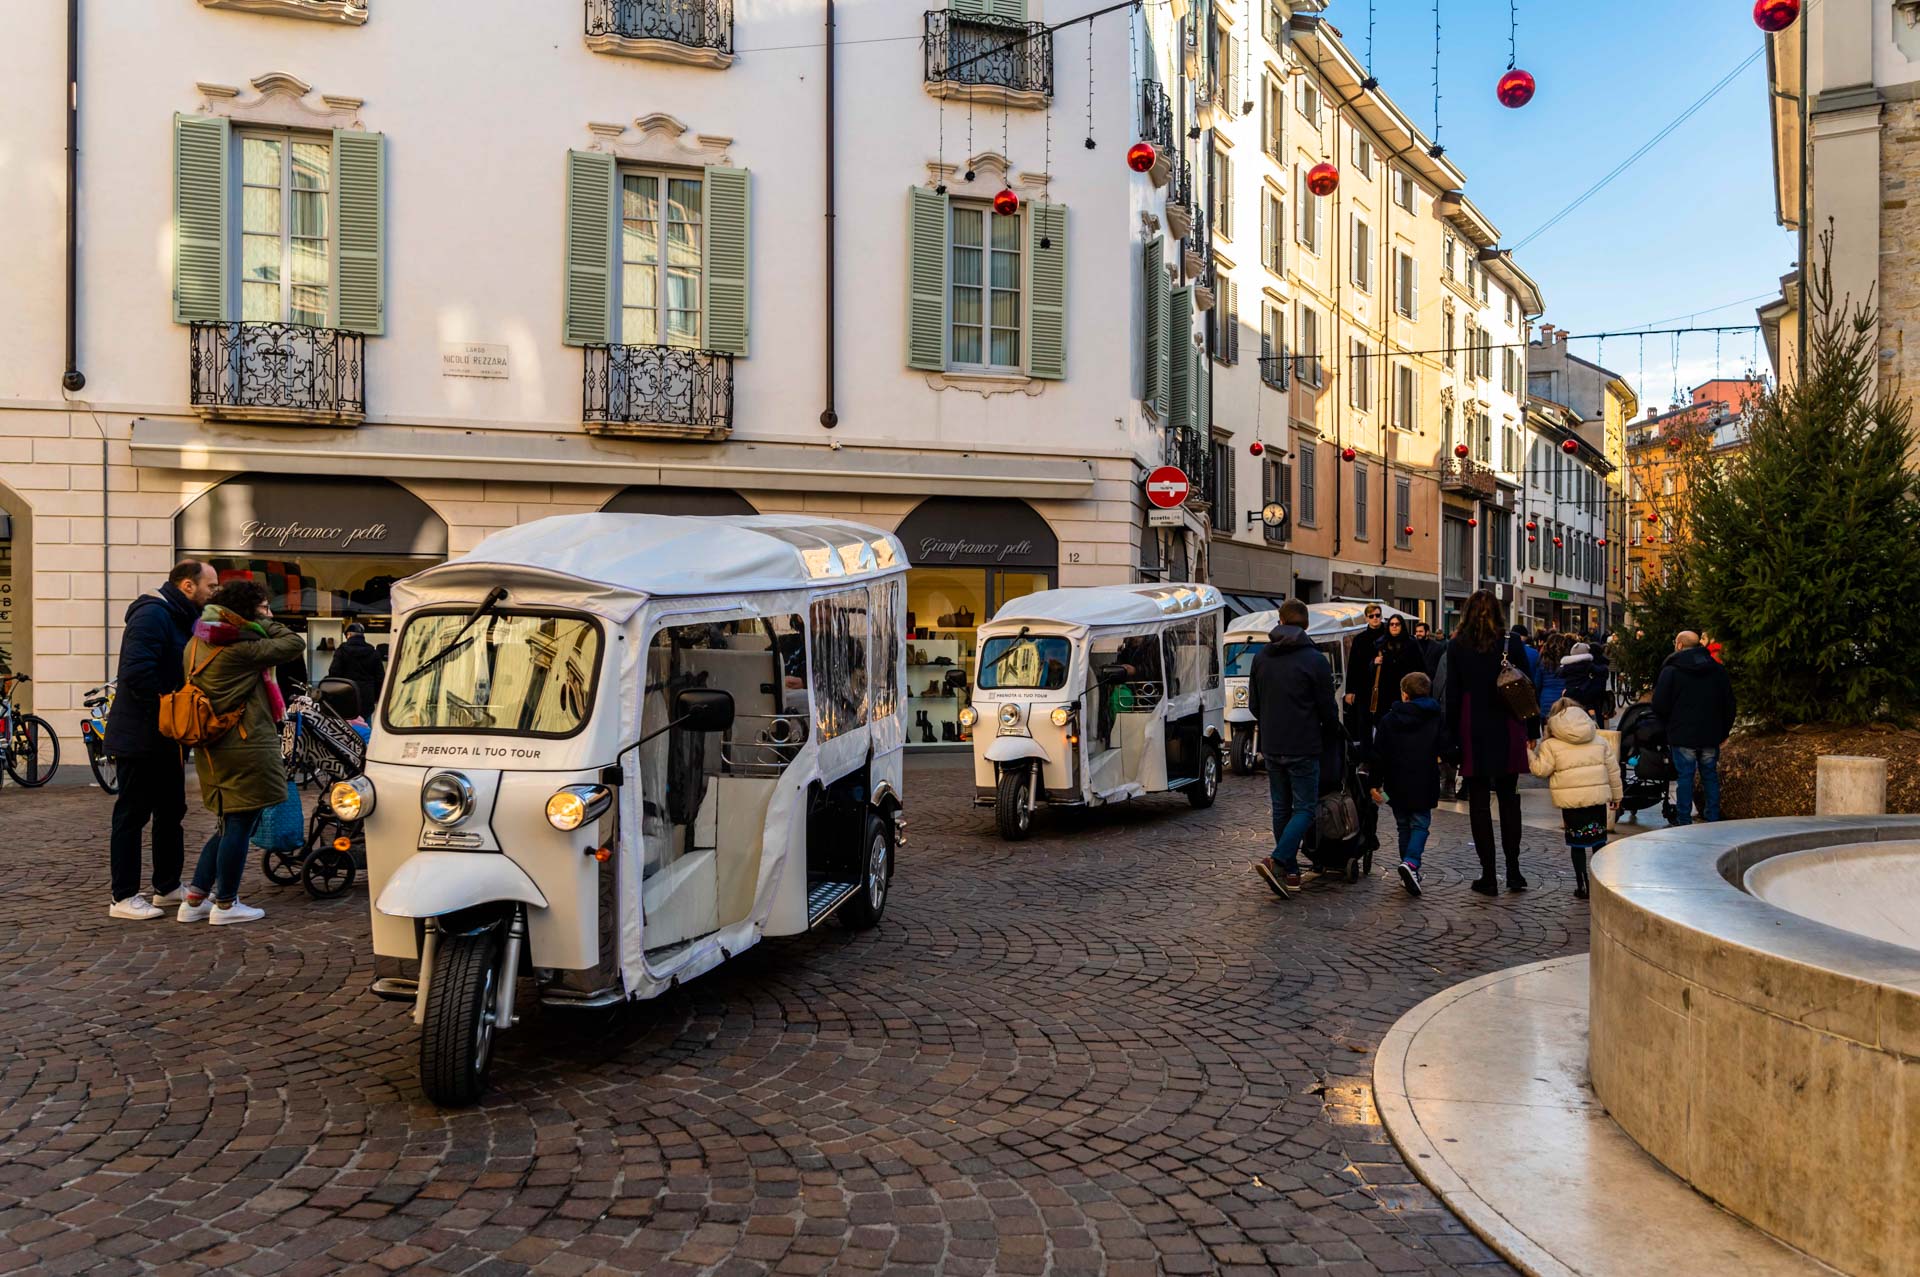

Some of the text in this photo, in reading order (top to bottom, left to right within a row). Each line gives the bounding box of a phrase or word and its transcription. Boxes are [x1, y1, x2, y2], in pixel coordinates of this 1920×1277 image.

[473, 356, 507, 366] REZZARA
[239, 520, 388, 548] Gianfranco pelle
[920, 537, 1032, 561] Gianfranco pelle
[1068, 552, 1080, 562] 12
[421, 746, 541, 758] PRENOTA IL TUO TOUR
